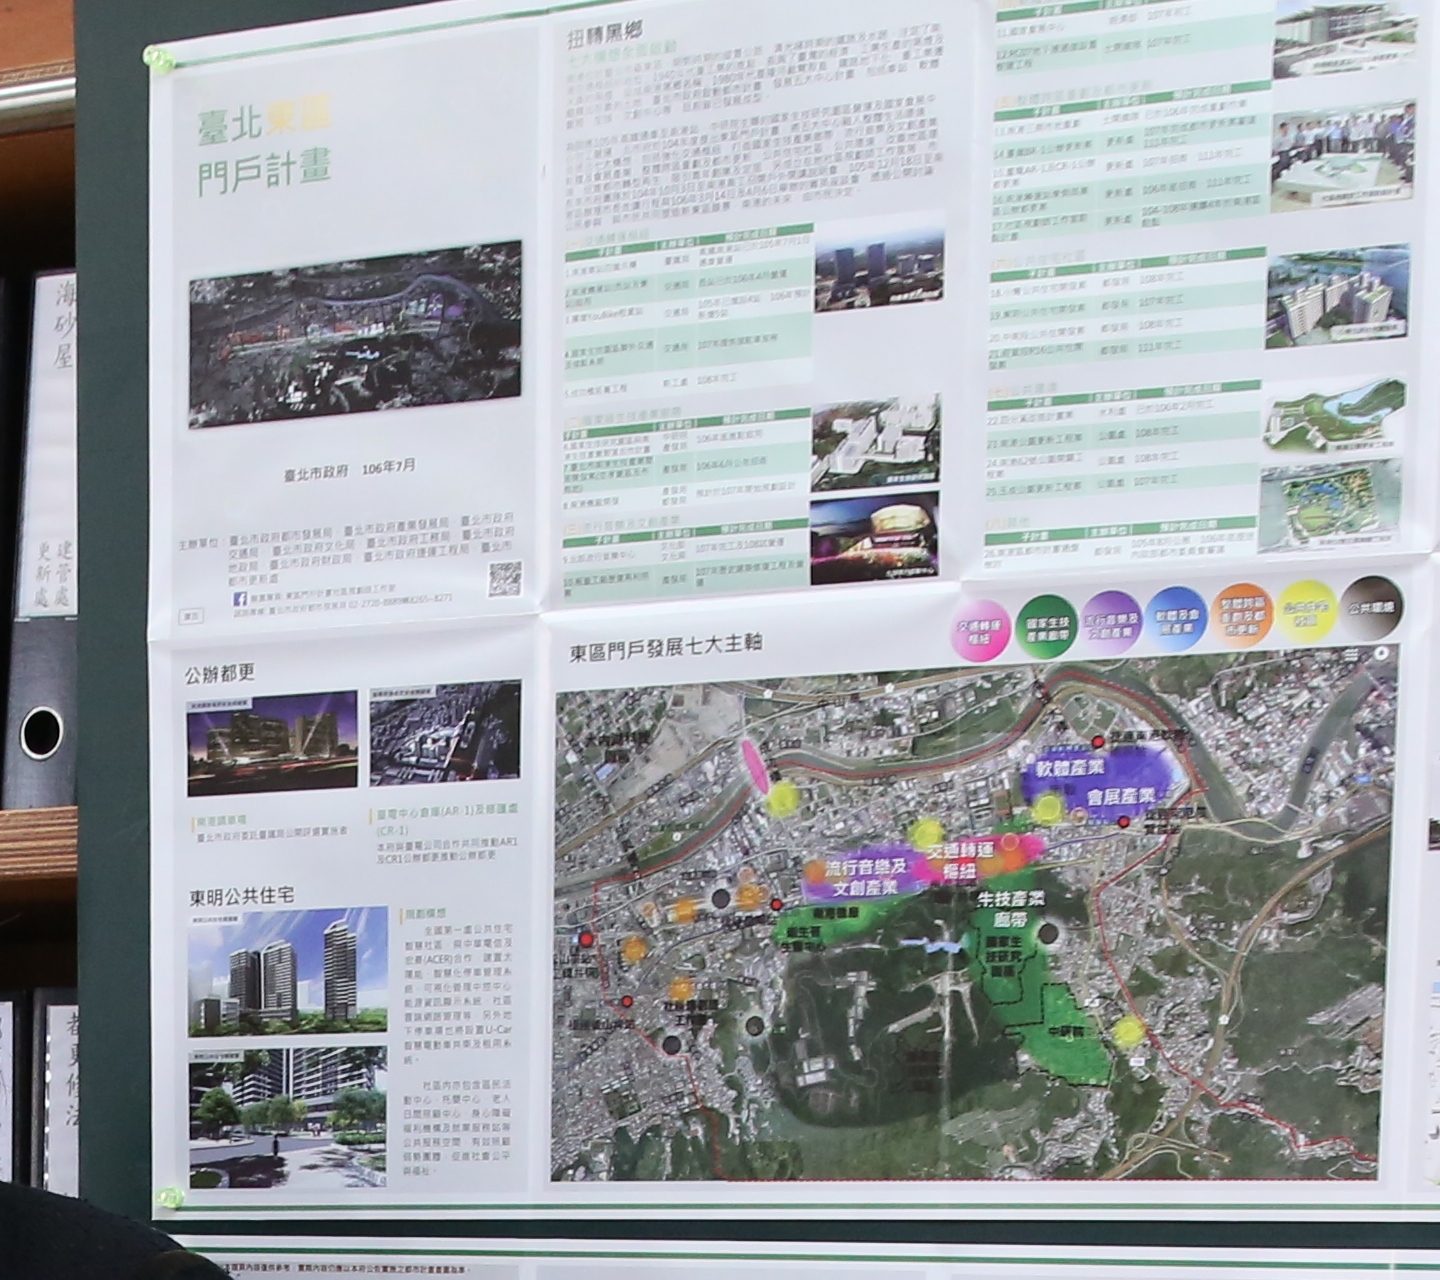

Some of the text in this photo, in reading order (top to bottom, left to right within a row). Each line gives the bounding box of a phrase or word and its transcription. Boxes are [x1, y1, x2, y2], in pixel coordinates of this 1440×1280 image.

[199, 146, 332, 198] 門戶計畫
[54, 281, 77, 369] 海砂屋
[284, 457, 416, 483] 臺北市政府 106年7月
[34, 542, 51, 608] 更新處
[53, 540, 73, 608] 建管處
[569, 633, 764, 664] 東區門戶發展七大主軸
[185, 662, 255, 685] 公辦都更
[1036, 760, 1104, 778] 軟體產業
[1087, 787, 1156, 805] 會展產業
[825, 858, 907, 877] 流行音樂及
[189, 886, 294, 908] 東明公共住宅
[834, 881, 898, 897] 文創產業
[977, 890, 1046, 908] 生技產業
[994, 913, 1027, 928] 廊帶
